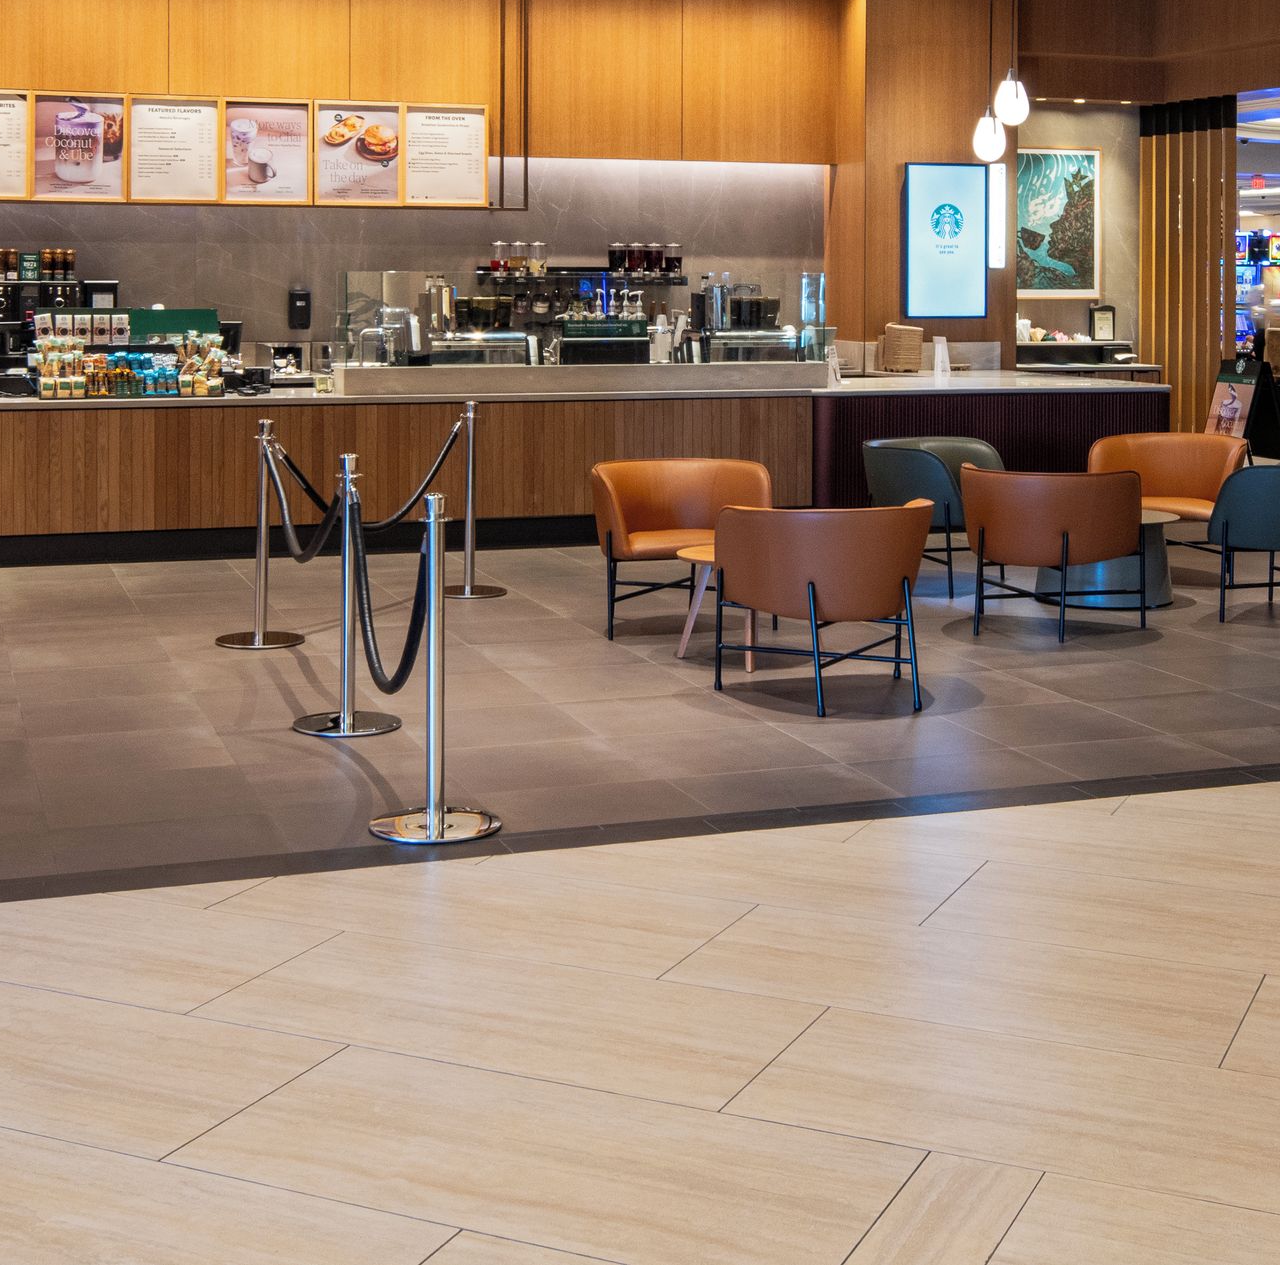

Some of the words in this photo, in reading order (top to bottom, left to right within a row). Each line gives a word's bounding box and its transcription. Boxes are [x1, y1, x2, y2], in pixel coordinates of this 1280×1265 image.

[248, 119, 276, 130] More
[45, 136, 92, 148] Coconut
[59, 149, 69, 160] &
[71, 149, 94, 161] Ube
[322, 159, 349, 170] Take
[350, 162, 363, 170] on
[330, 172, 347, 183] the
[348, 172, 368, 185] day
